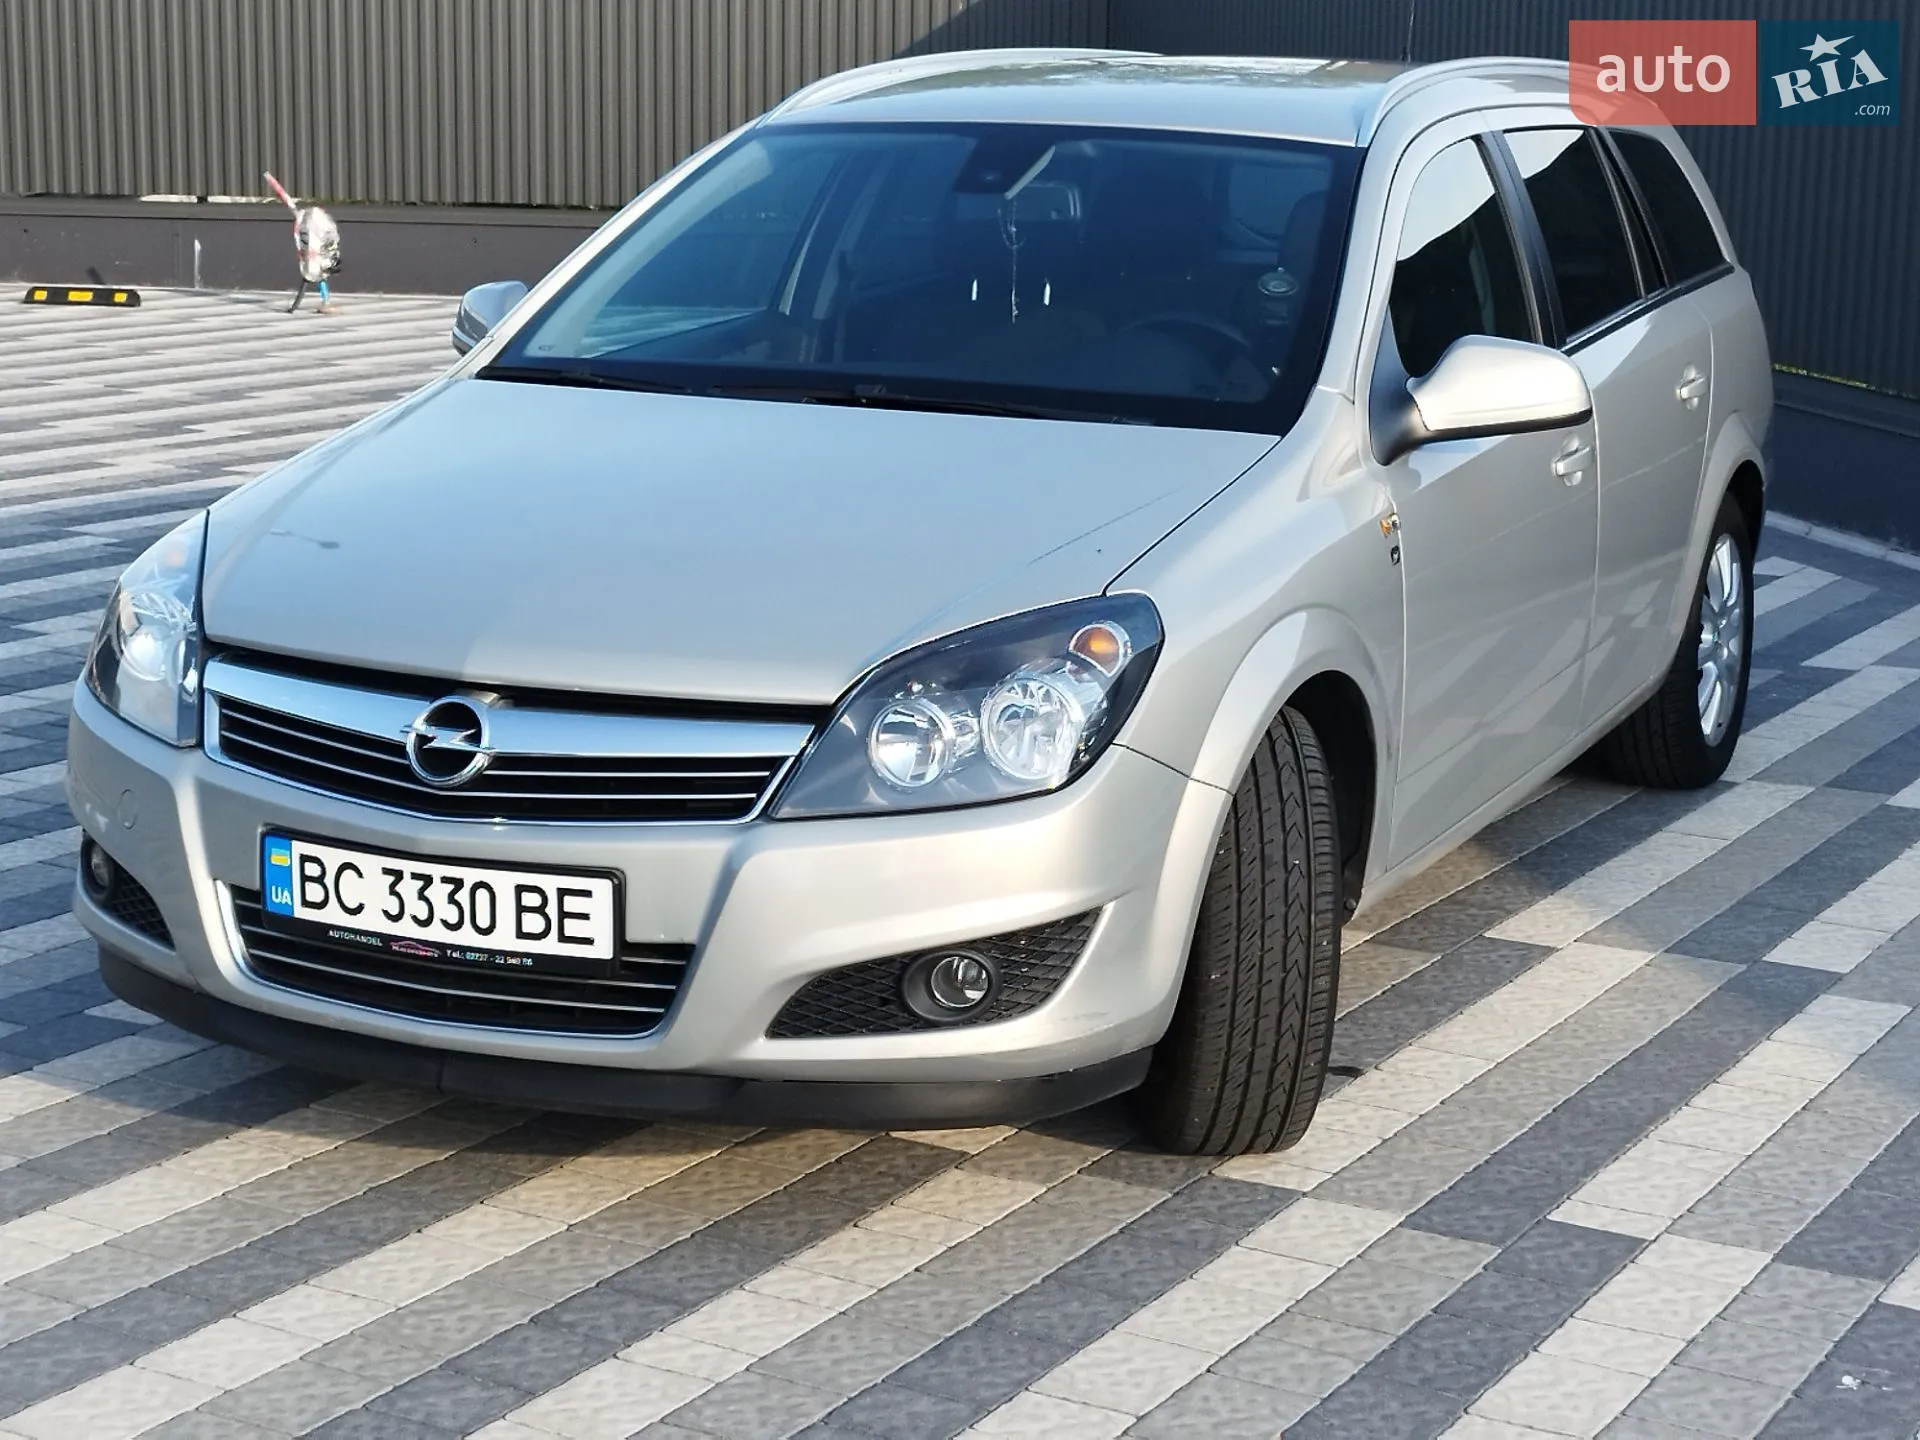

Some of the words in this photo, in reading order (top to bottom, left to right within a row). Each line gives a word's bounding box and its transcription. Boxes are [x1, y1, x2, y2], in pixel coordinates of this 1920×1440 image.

[271, 884, 292, 906] UA
[299, 854, 365, 916] BC
[381, 867, 497, 937] 3330
[514, 884, 595, 946] BE
[328, 930, 383, 946] AUTOHANDEL
